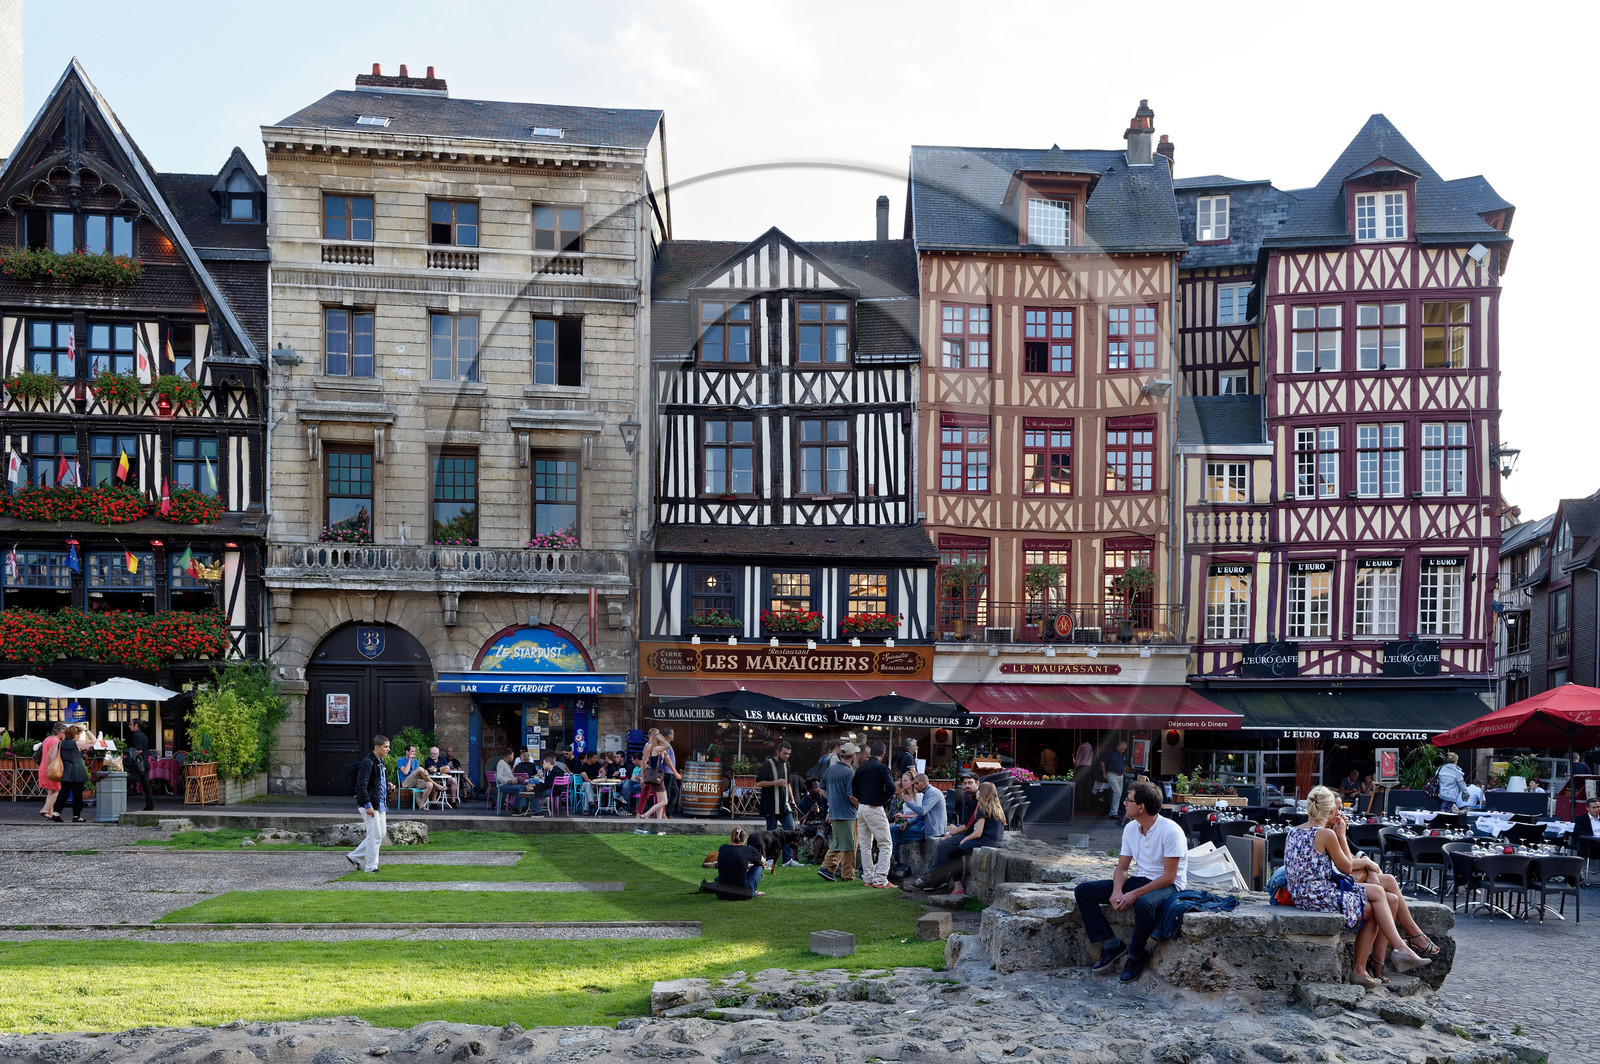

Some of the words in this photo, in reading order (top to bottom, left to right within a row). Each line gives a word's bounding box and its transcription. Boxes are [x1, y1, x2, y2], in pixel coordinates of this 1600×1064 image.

[363, 631, 380, 646] 33
[495, 644, 510, 658] LE
[513, 646, 563, 660] STARDUST
[705, 654, 738, 670] LES
[745, 655, 870, 671] MARAICHERS
[1243, 656, 1274, 665] L'EURO
[1275, 655, 1299, 664] CAFE
[1383, 655, 1415, 664] L'EURO
[1416, 654, 1440, 663] CAFE
[1013, 664, 1027, 672] LE
[1032, 664, 1110, 673] MAUPASSANT
[461, 684, 477, 692] BAR
[499, 684, 510, 692] LE
[511, 684, 555, 693] STARDUST
[576, 685, 602, 693] TABAC
[653, 708, 666, 718] LES
[668, 708, 715, 718] MARAICHERS
[744, 709, 763, 720] LES
[766, 710, 828, 723] MARAICHERS
[1568, 710, 1592, 723] Le
[842, 713, 866, 722] Depuis
[866, 714, 882, 722] 1912
[888, 715, 904, 723] LES
[905, 715, 960, 726] MARAICHERS
[965, 718, 974, 726] 37
[986, 716, 1045, 726] Restaurant
[1333, 731, 1359, 739] BARS
[1372, 732, 1428, 740] COCKTAILS
